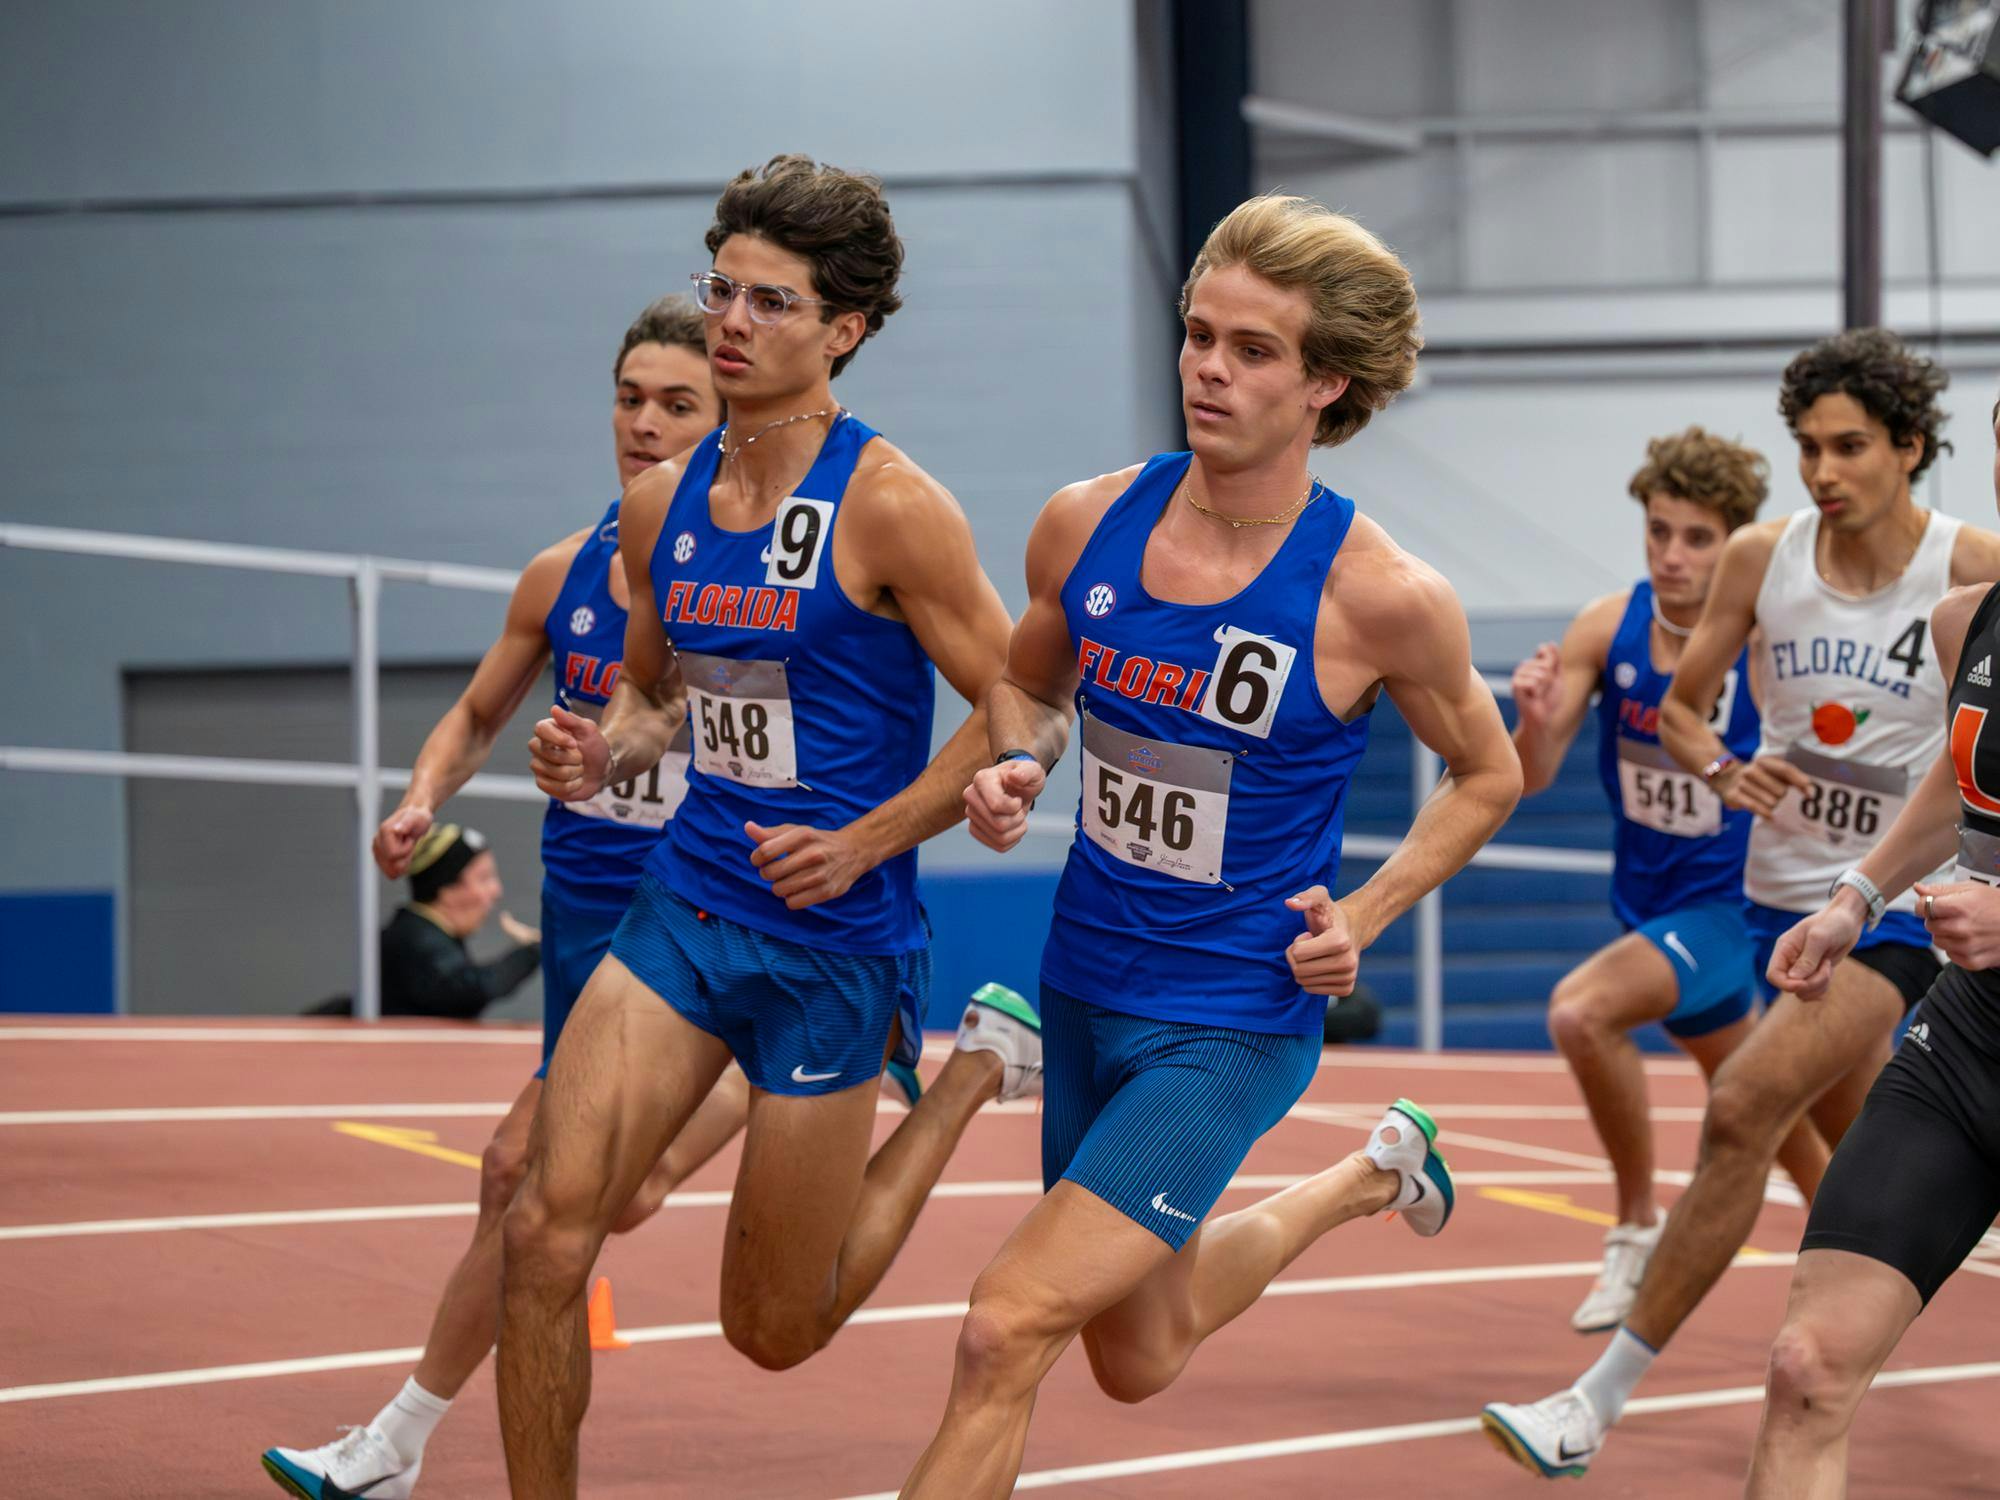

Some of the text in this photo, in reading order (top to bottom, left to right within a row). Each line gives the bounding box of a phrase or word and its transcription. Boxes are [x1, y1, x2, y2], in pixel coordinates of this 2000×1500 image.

[674, 532, 695, 563] SEC
[777, 503, 822, 580] 9
[663, 581, 799, 632] FLORIDA
[1085, 585, 1115, 617] SEC
[1887, 617, 1927, 677] 4
[1215, 640, 1278, 725] 6
[1967, 672, 1992, 687] adidas
[700, 695, 769, 761] 548
[1098, 765, 1197, 851] 546
[1636, 771, 1697, 817] 541
[1801, 782, 1881, 835] 886
